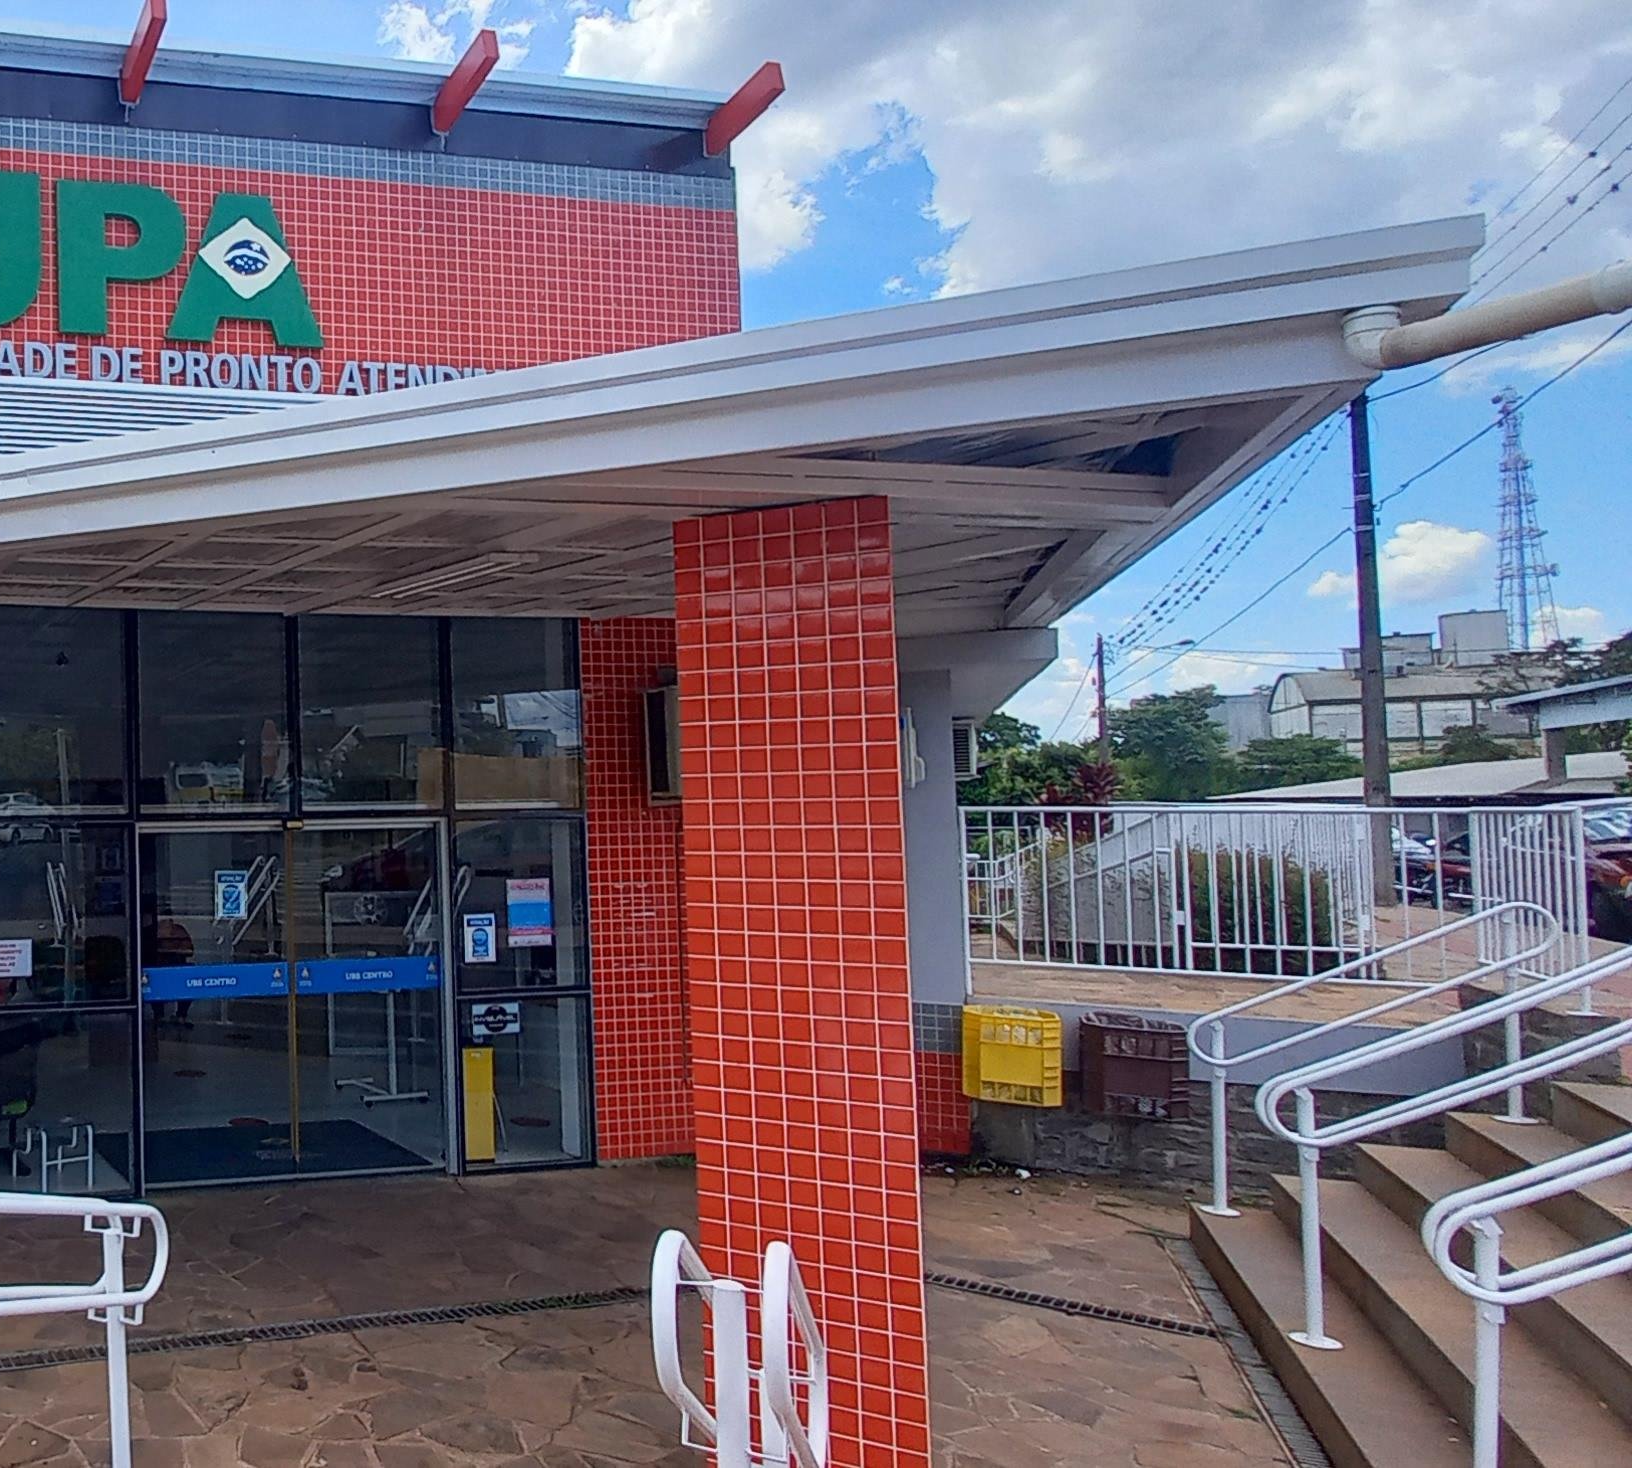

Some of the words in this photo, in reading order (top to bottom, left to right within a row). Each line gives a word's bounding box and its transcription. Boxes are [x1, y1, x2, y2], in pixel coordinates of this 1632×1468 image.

[90, 344, 145, 384] DE
[160, 350, 323, 394] PRONTO
[345, 971, 361, 981] UBS
[362, 970, 393, 980] CENTRO
[186, 978, 203, 987] UBS
[204, 977, 237, 987] CENTRO
